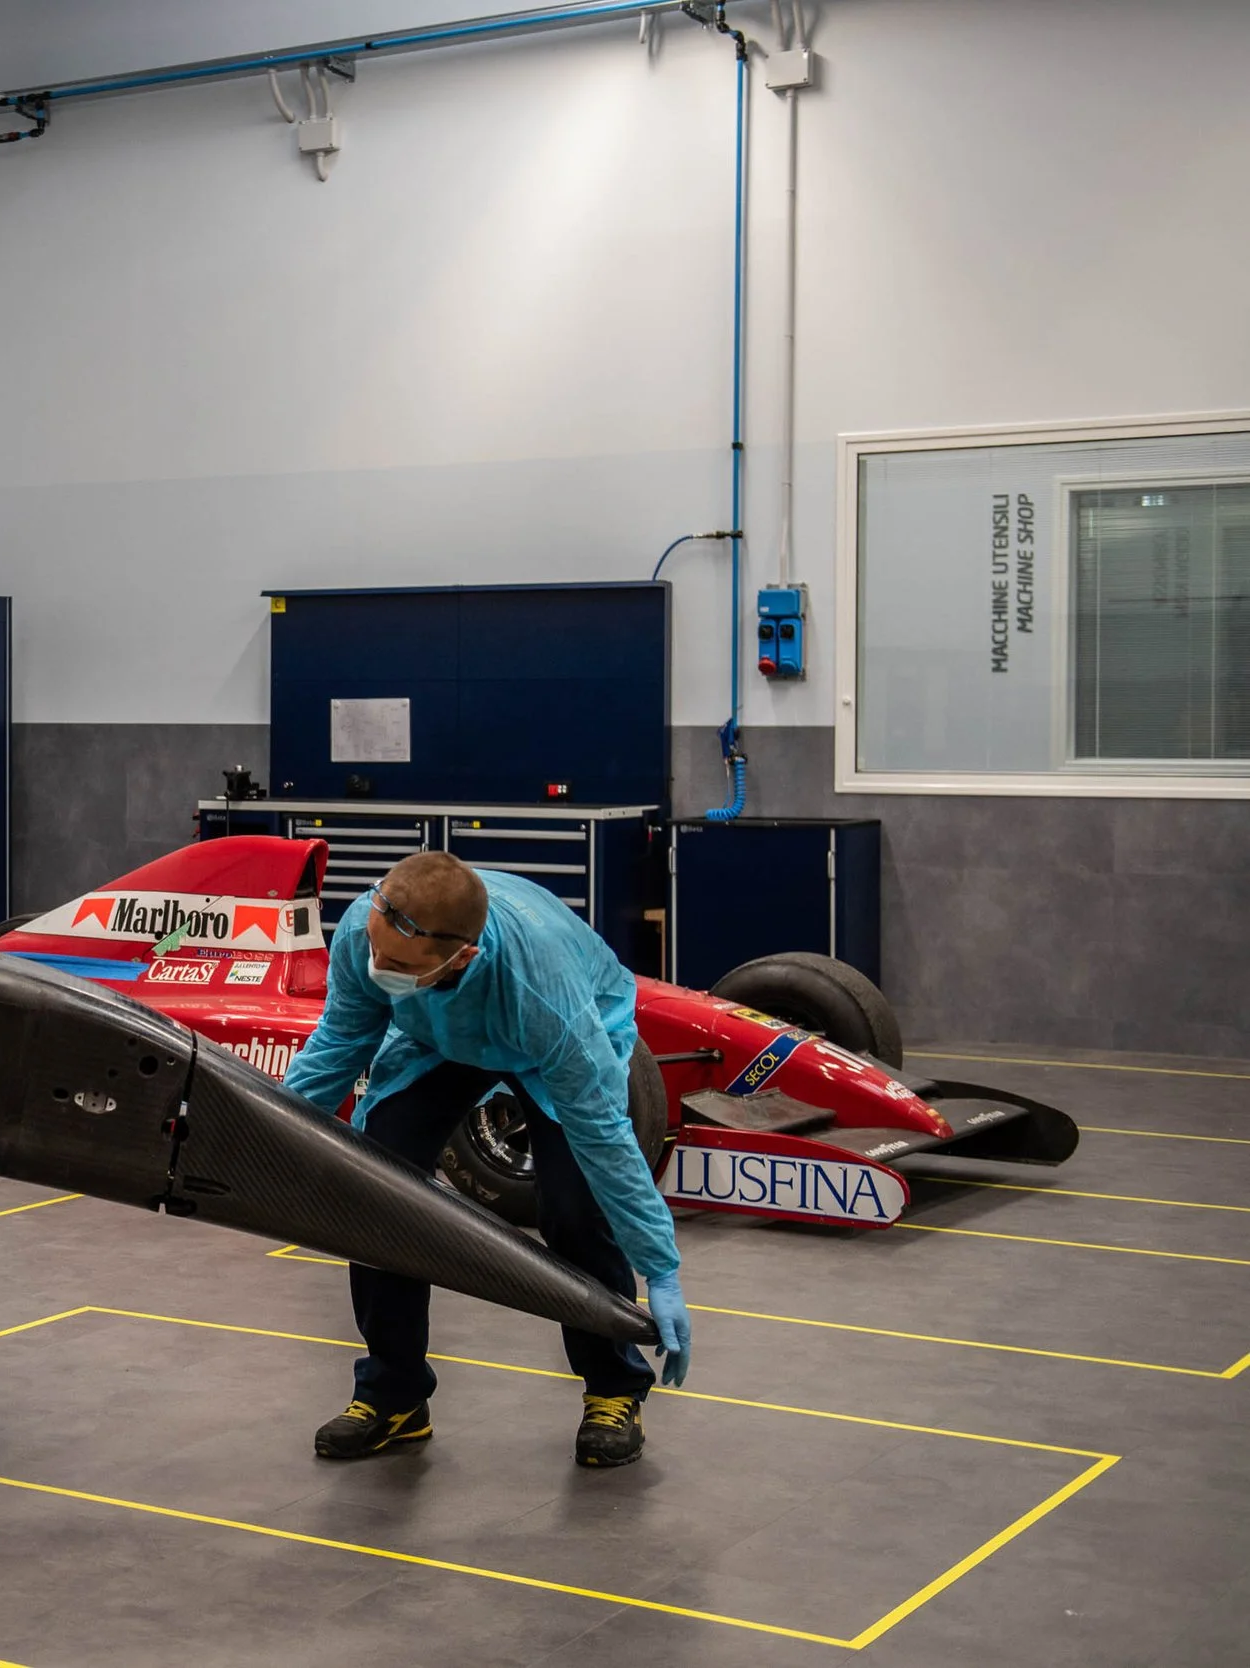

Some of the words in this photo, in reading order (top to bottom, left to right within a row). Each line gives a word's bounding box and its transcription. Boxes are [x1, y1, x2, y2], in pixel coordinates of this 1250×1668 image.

[992, 494, 1010, 575] UTENSILI
[1017, 493, 1035, 545] SHOP
[1016, 549, 1034, 634] MACHINE
[991, 581, 1009, 673] MACCHINE
[111, 898, 229, 940] Marlboro
[235, 975, 263, 983] NESTE
[216, 1036, 299, 1078] chini
[744, 1052, 780, 1086] SECOL
[674, 1149, 890, 1220] LUSFINA
